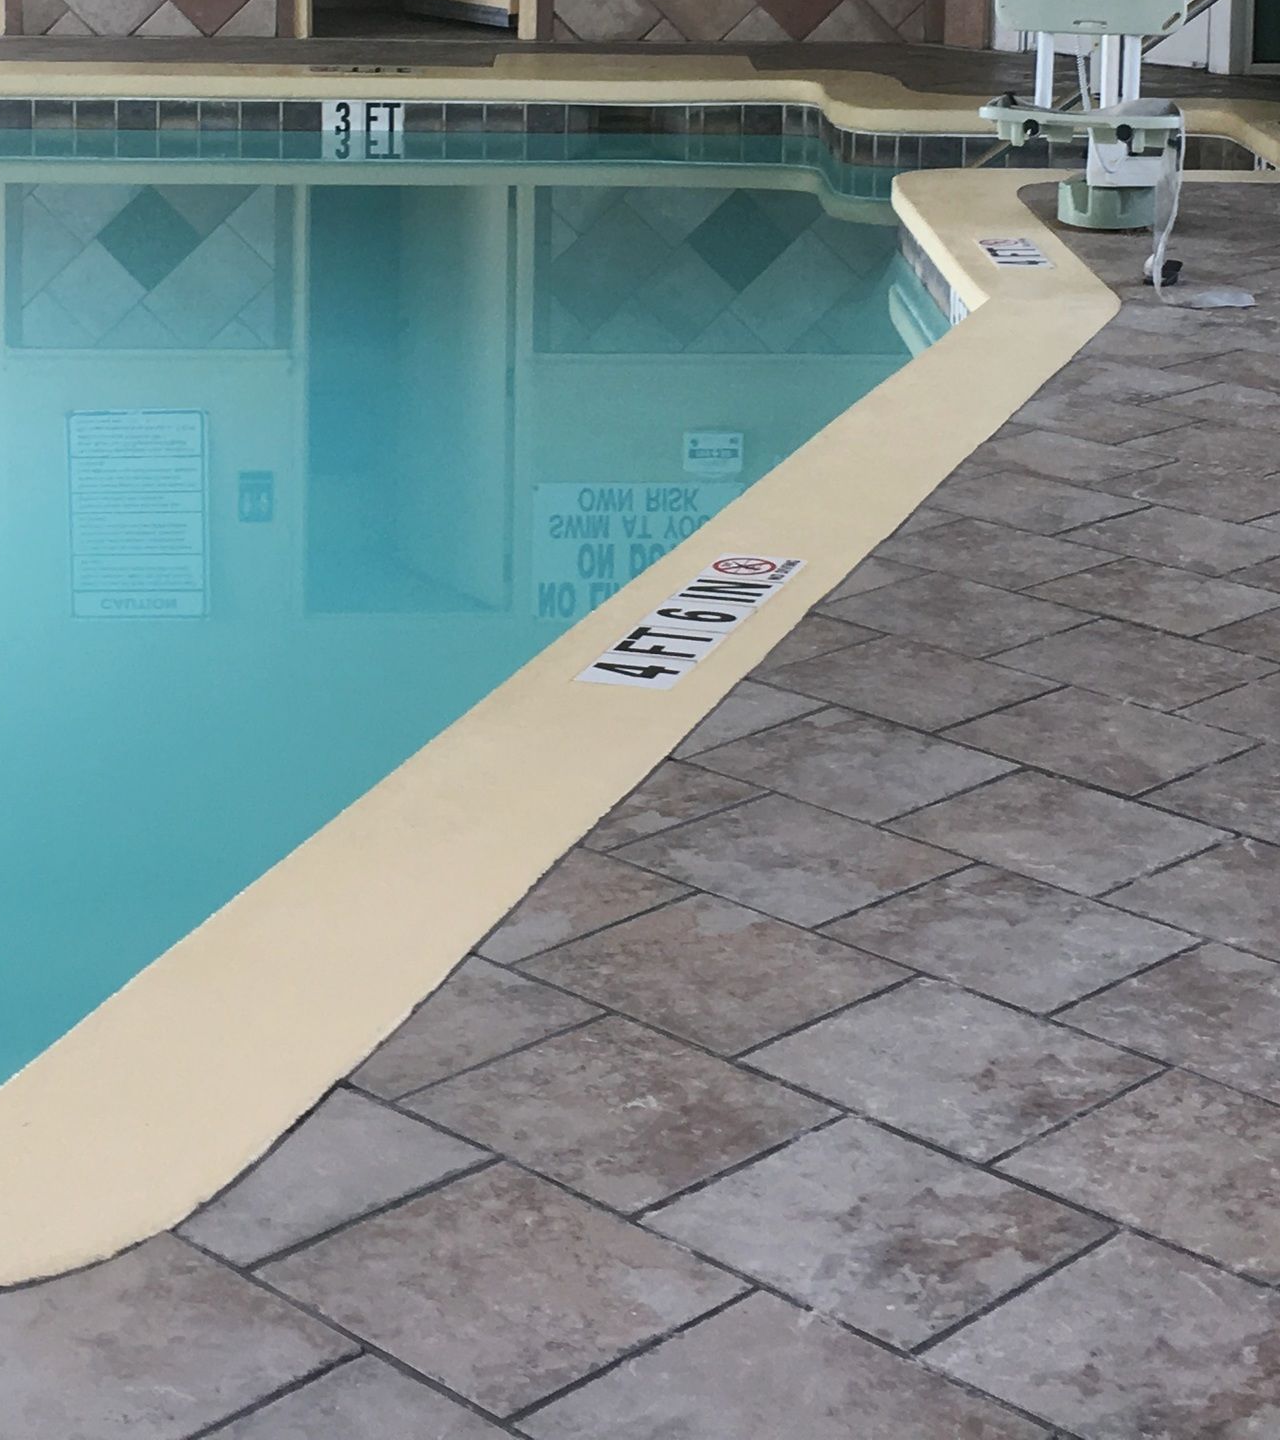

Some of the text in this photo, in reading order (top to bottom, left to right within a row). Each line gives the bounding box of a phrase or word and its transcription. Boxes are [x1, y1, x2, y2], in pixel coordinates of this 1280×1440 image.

[335, 102, 401, 132] 3 FT
[592, 578, 772, 679] 4 FT 6 IN
